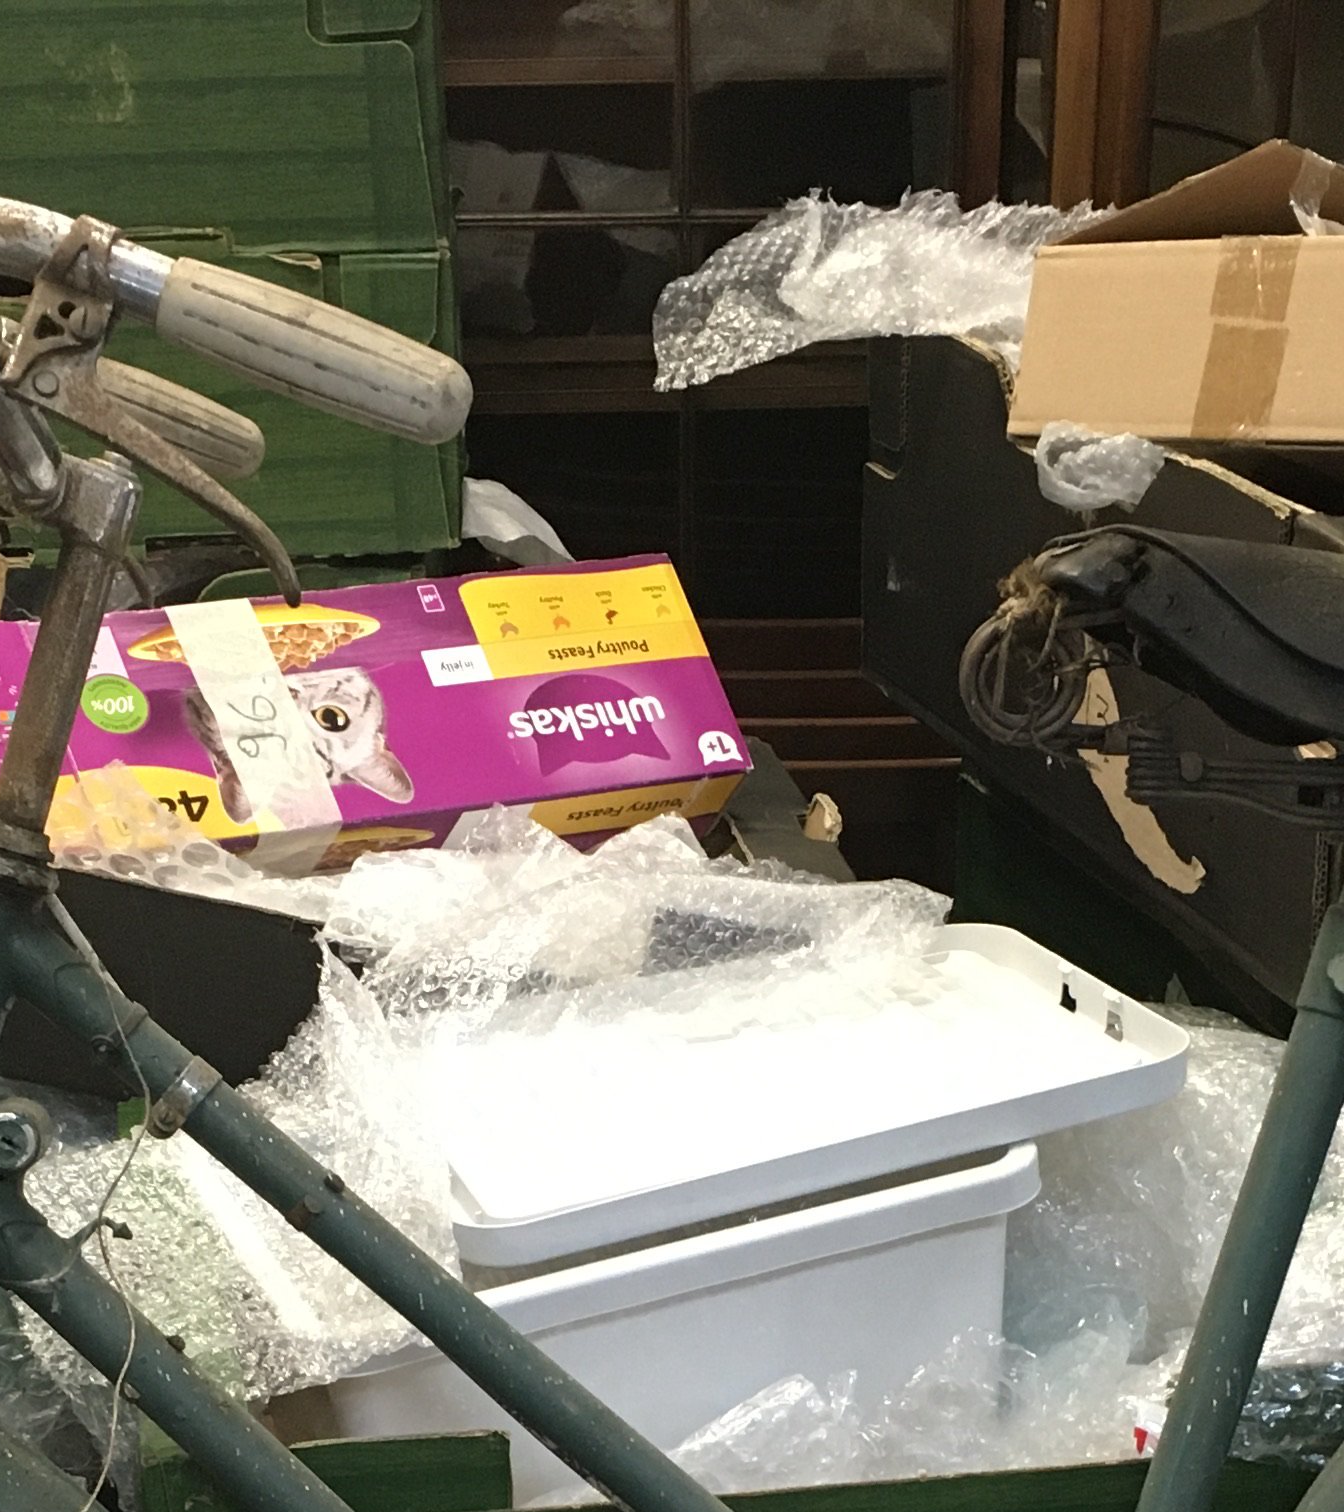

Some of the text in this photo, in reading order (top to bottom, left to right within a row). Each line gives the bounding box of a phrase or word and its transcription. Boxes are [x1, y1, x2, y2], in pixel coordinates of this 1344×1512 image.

[548, 638, 650, 661] Poultry Feasts
[440, 661, 462, 672] jelly
[90, 695, 135, 715] 100%
[508, 695, 667, 742] whiskas
[707, 735, 731, 756] 1+
[567, 805, 622, 821] Feasts
